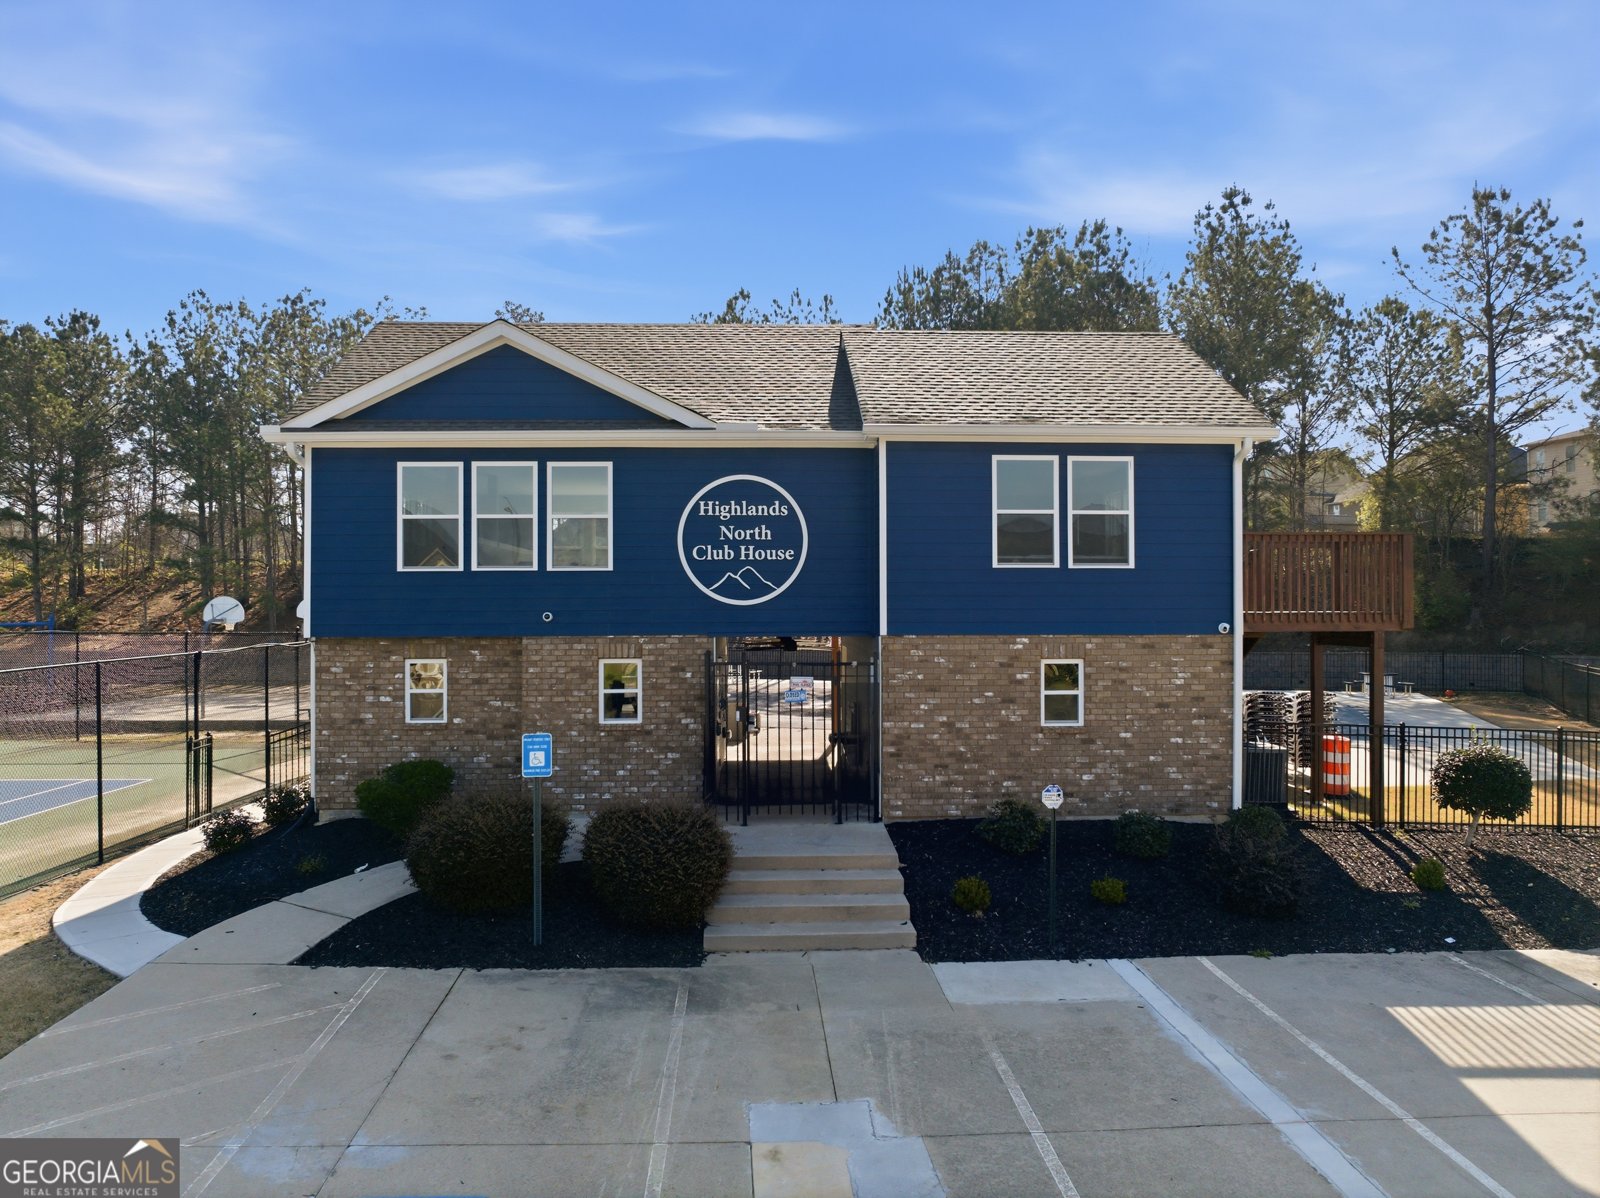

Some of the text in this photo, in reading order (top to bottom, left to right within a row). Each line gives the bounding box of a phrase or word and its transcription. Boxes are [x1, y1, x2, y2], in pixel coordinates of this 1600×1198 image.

[698, 501, 789, 521] Highlands
[719, 524, 772, 541] North
[692, 545, 795, 561] Club House
